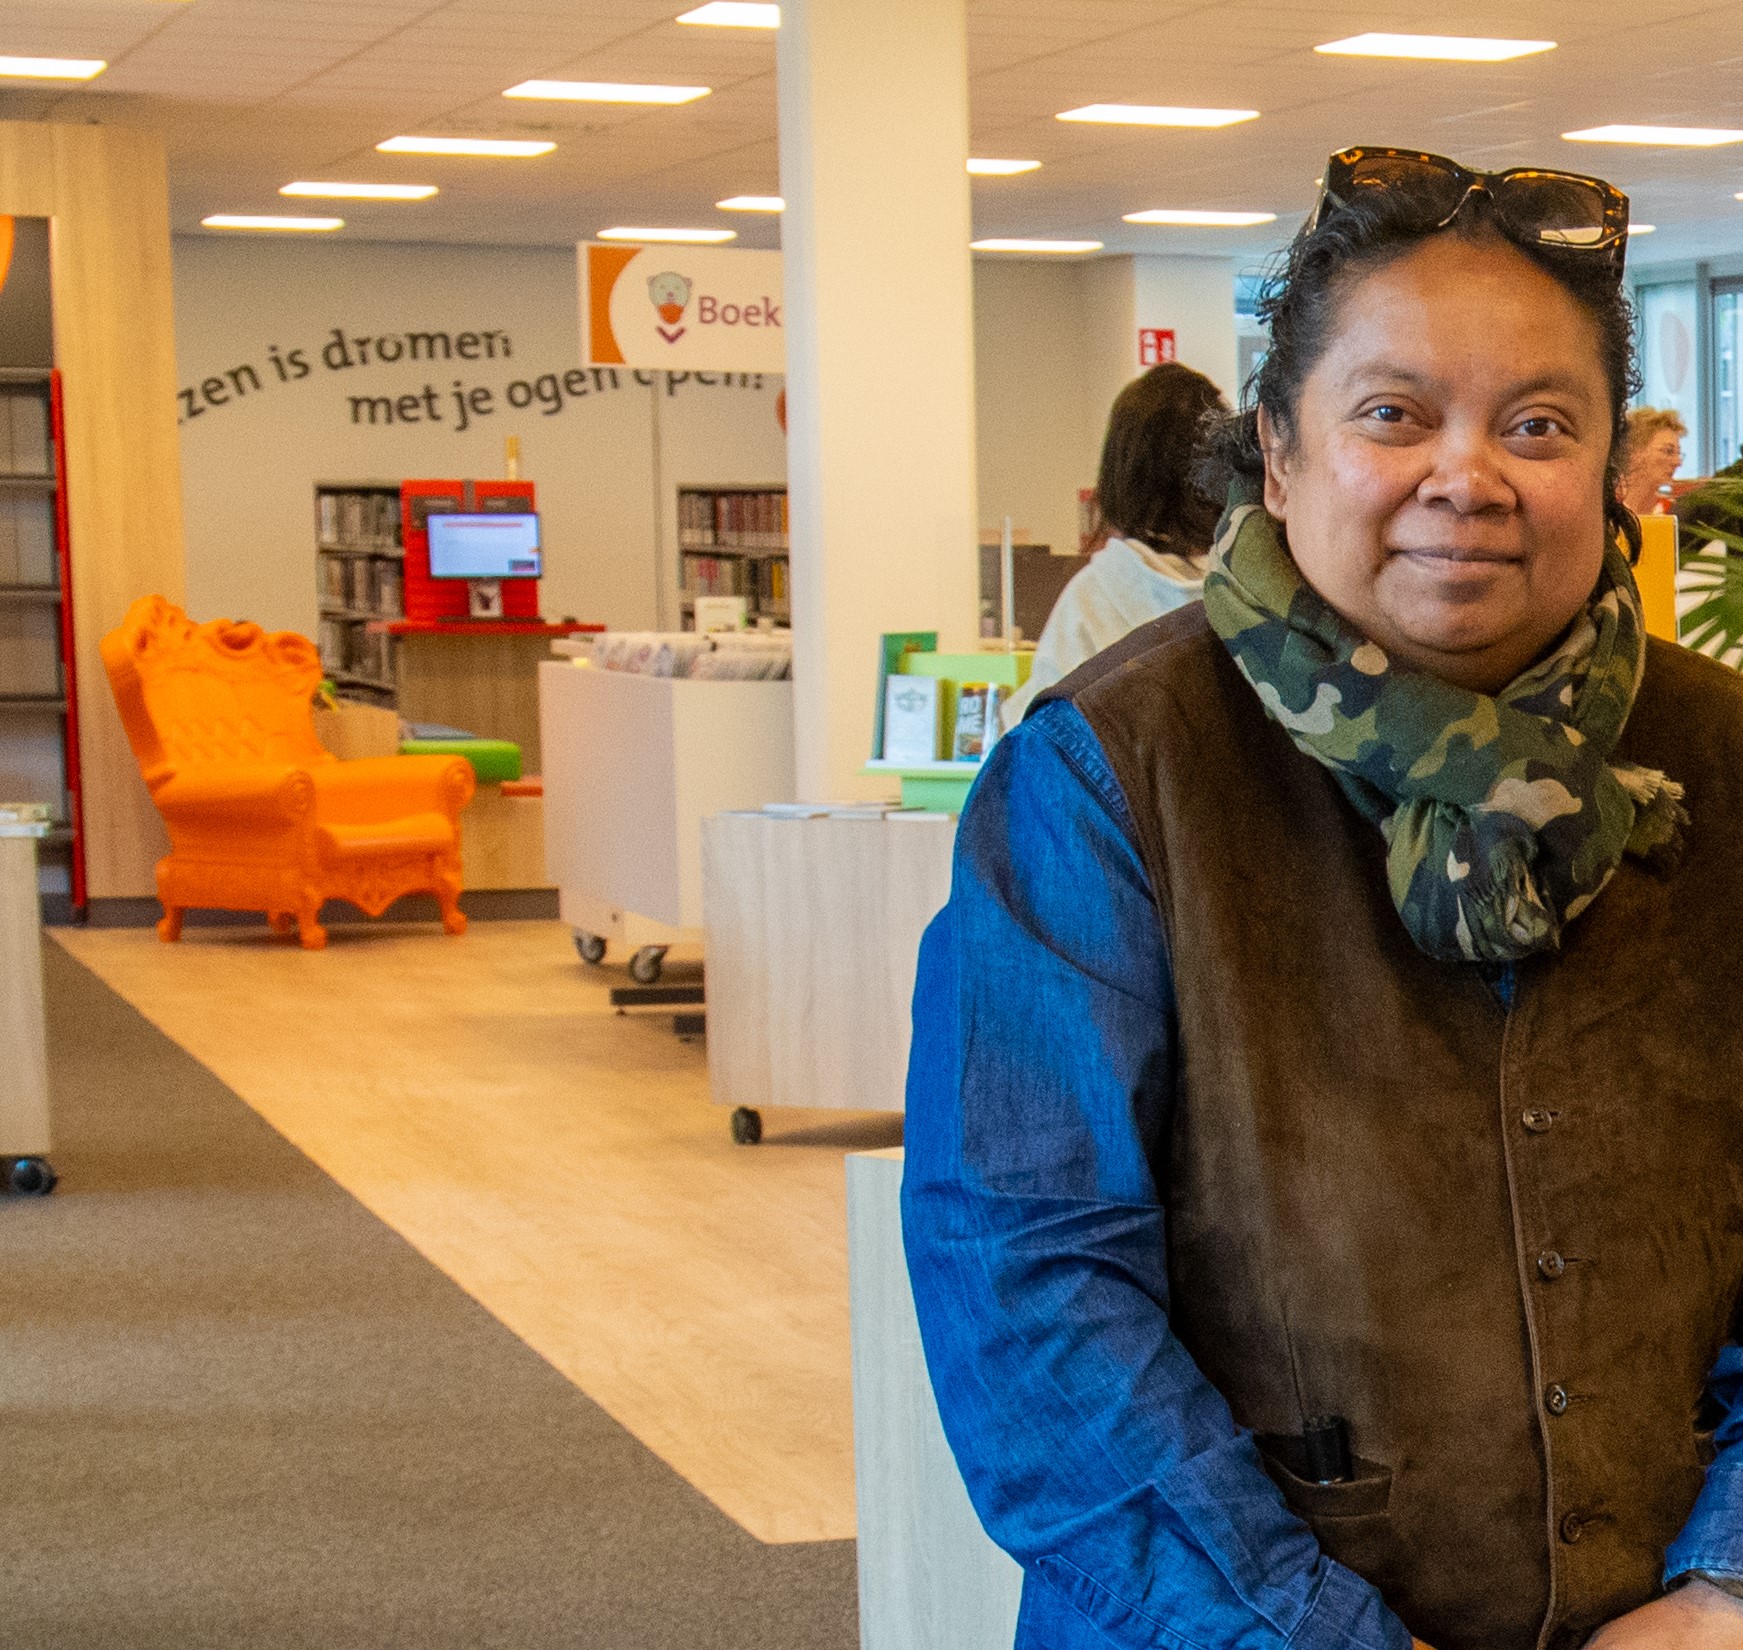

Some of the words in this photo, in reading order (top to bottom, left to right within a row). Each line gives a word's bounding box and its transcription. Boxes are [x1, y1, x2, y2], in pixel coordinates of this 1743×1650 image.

[266, 345, 310, 382] is
[347, 384, 441, 424] met
[453, 380, 494, 432] je
